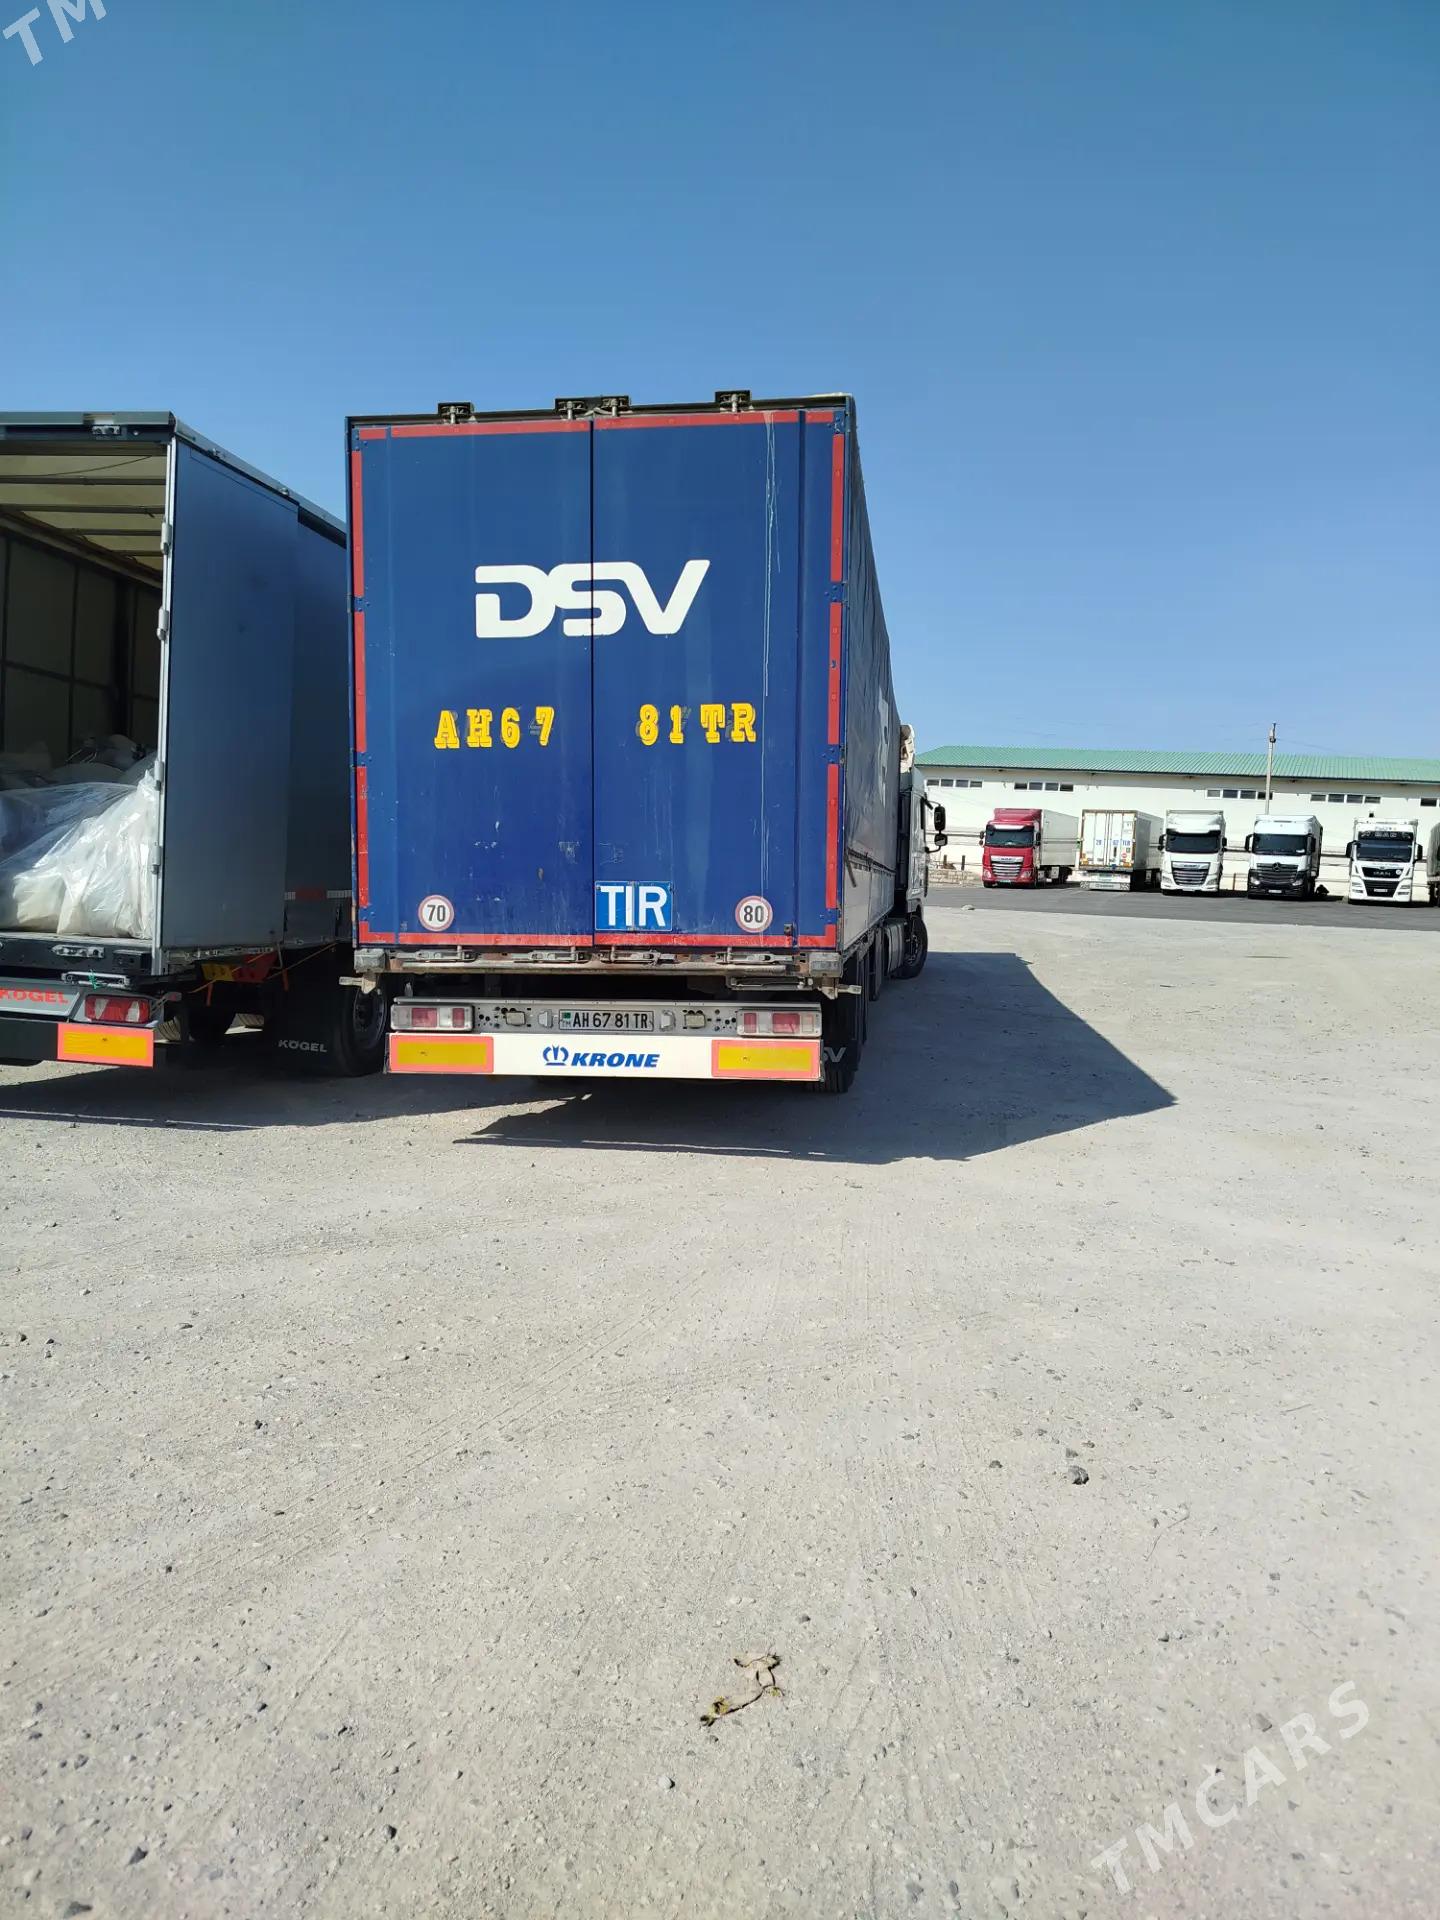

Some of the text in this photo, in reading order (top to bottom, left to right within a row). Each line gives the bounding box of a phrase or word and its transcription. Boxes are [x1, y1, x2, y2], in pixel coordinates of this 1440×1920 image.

[475, 559, 711, 638] DSV
[427, 904, 447, 923] 70
[599, 885, 668, 926] TIR
[743, 904, 765, 923] 80
[571, 1052, 660, 1068] KRONE
